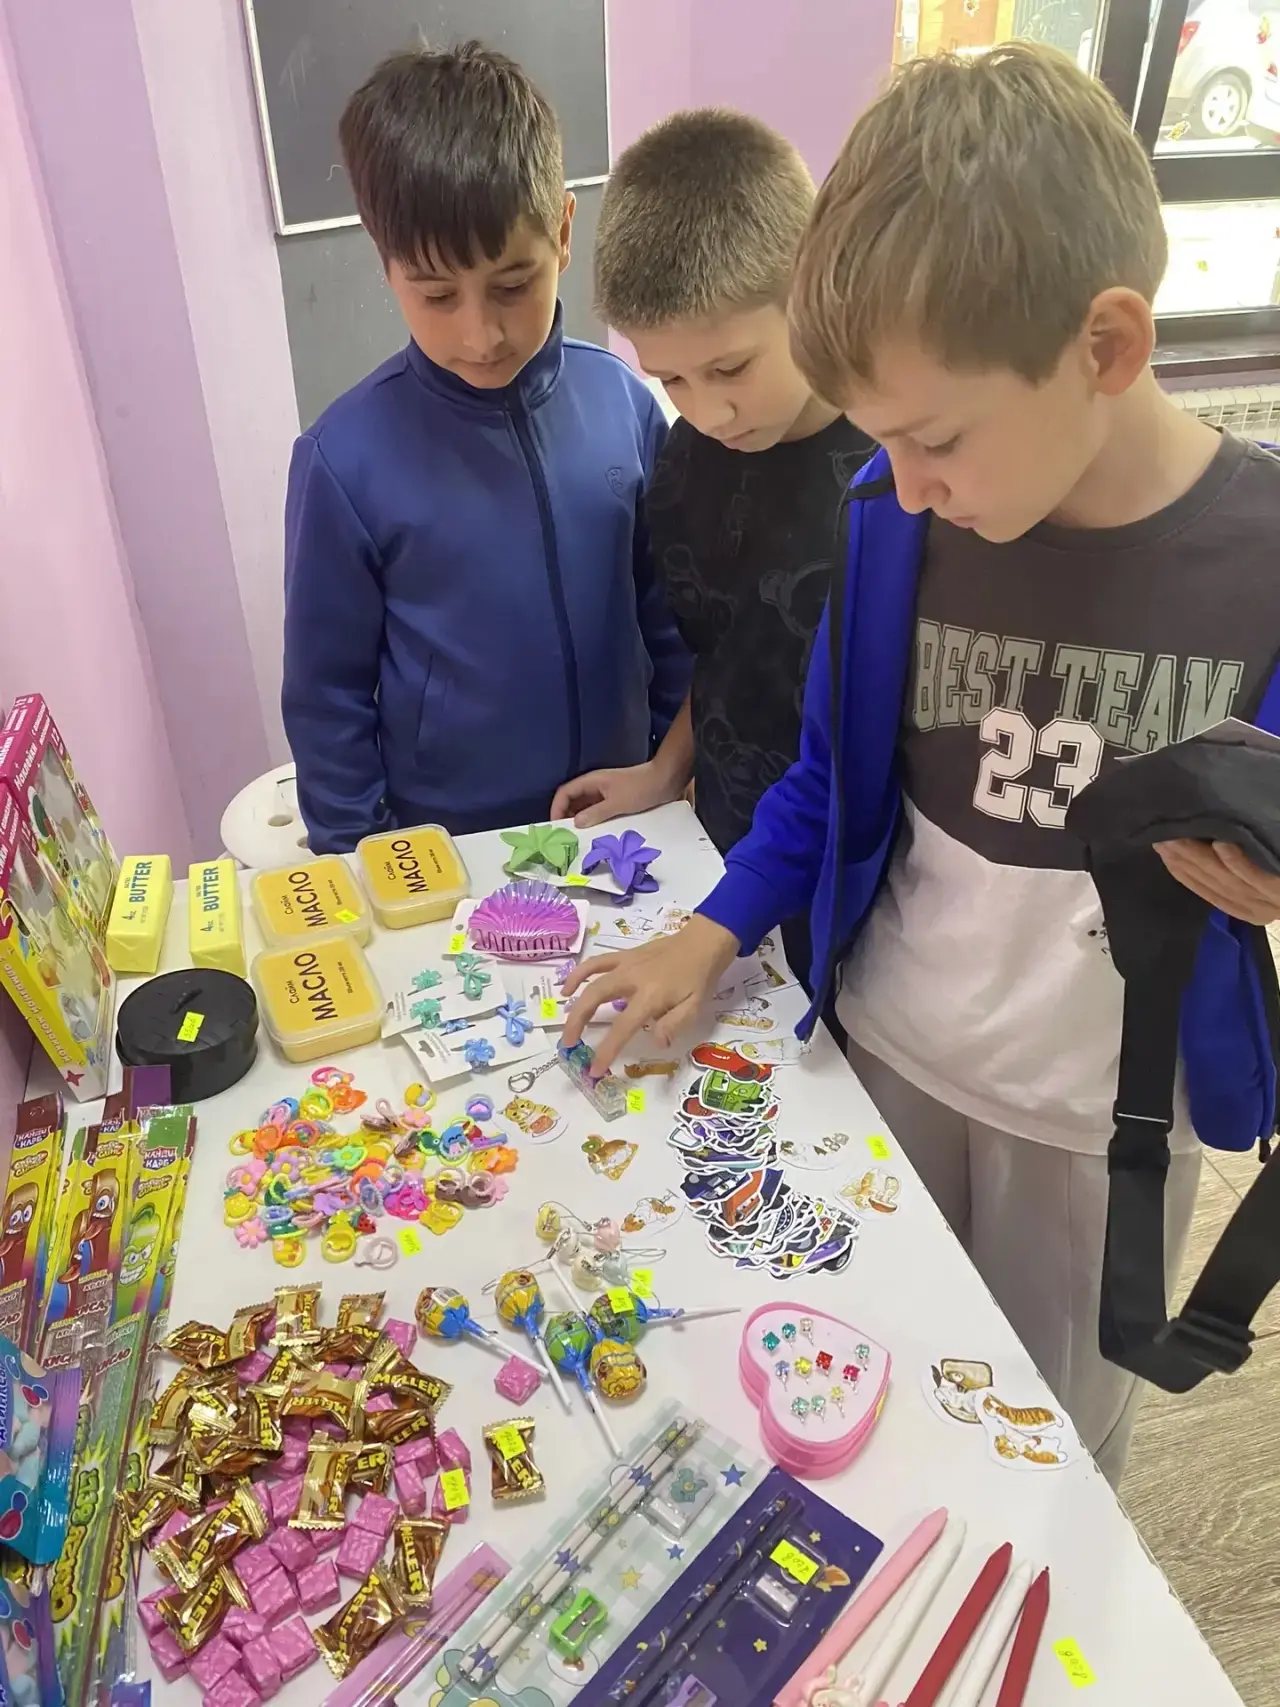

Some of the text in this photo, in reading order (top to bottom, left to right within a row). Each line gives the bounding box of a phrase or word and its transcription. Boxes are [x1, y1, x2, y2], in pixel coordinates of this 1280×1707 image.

[913, 618, 1244, 754] BEST TEAM
[14, 741, 38, 791] Наклейки
[973, 707, 1104, 829] 23
[129, 861, 152, 903] BUTTER
[203, 865, 219, 912] BUTTER
[391, 840, 429, 893] МАСЛО
[288, 871, 328, 928] МАСЛО
[293, 952, 338, 1021] МАСЛО
[292, 1396, 347, 1413] MELLER
[373, 1373, 441, 1399] MELLER
[256, 1393, 273, 1447] ELLER
[185, 1498, 243, 1573] MELLER
[401, 1526, 424, 1594] MELLER
[181, 1573, 226, 1640] ELLER
[335, 1573, 381, 1658] MELLER
